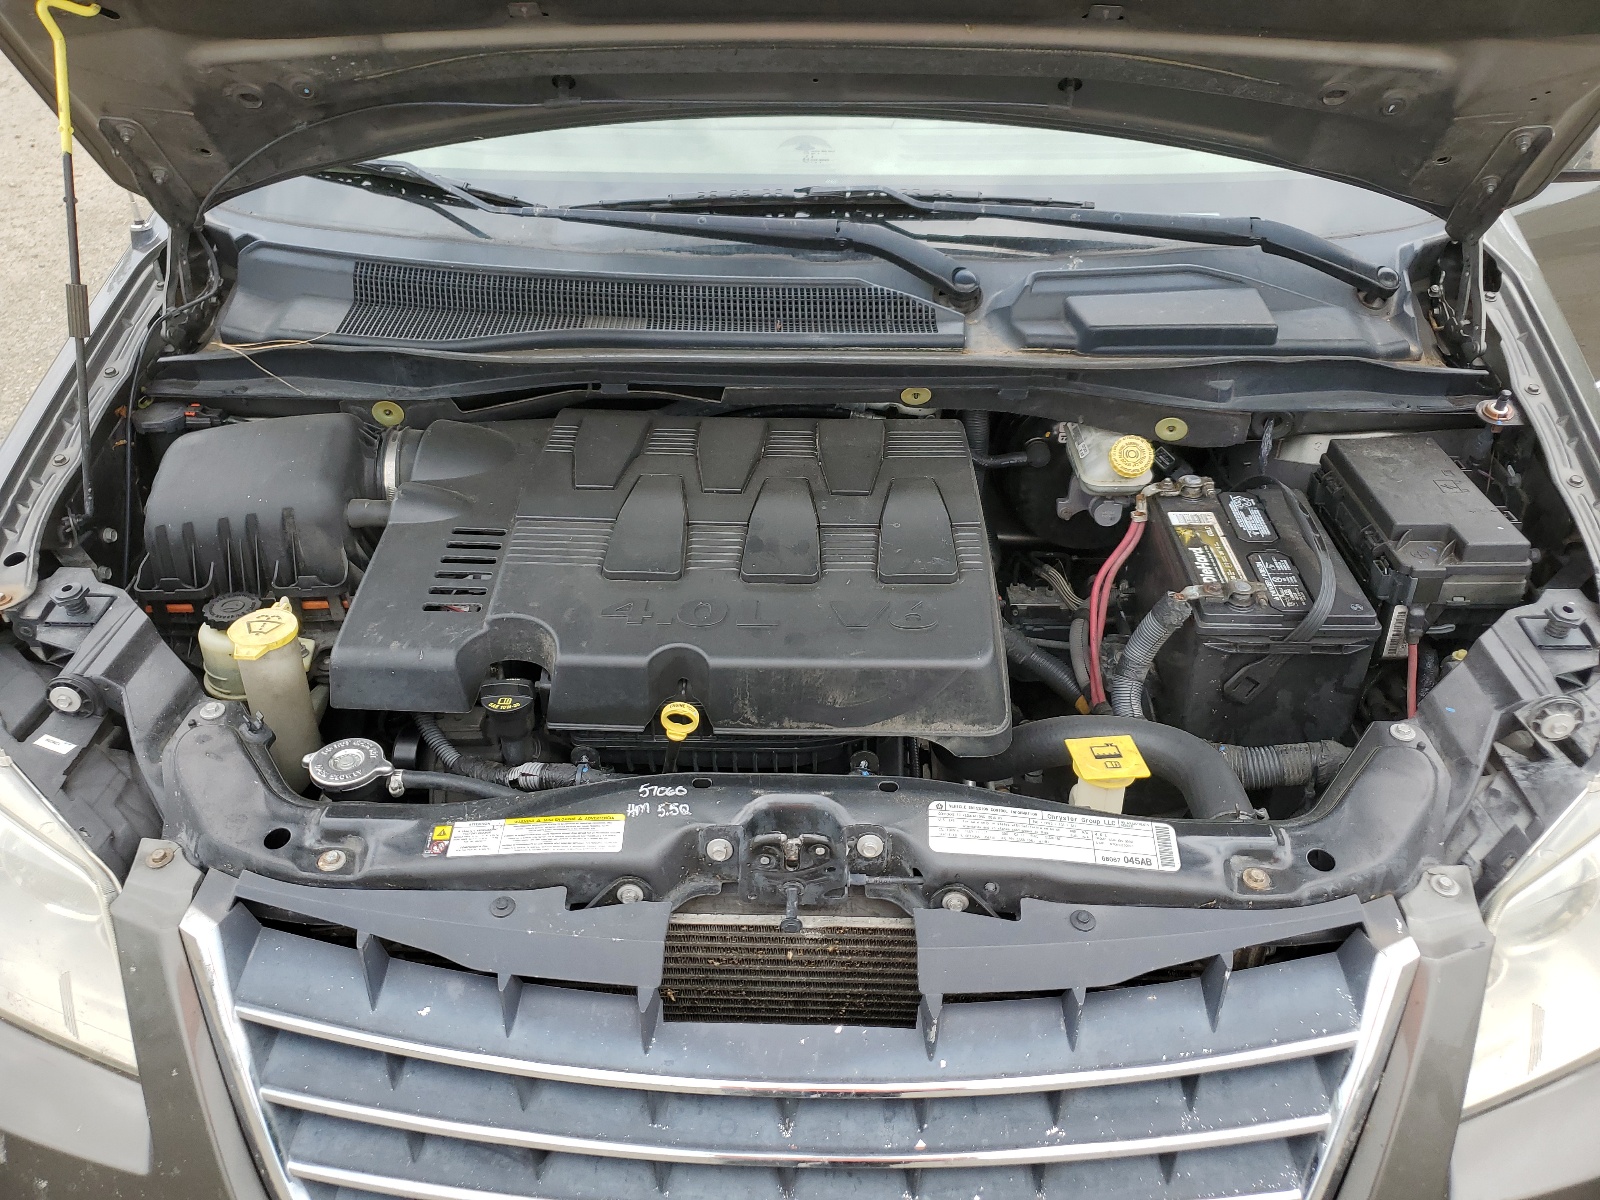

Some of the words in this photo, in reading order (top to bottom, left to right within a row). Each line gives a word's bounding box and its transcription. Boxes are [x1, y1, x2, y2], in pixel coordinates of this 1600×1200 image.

[1188, 546, 1218, 583] DieHard
[829, 599, 938, 630] V6
[1047, 813, 1078, 823] Chrysler
[1081, 817, 1101, 826] Group
[1123, 855, 1153, 866] 045AB
